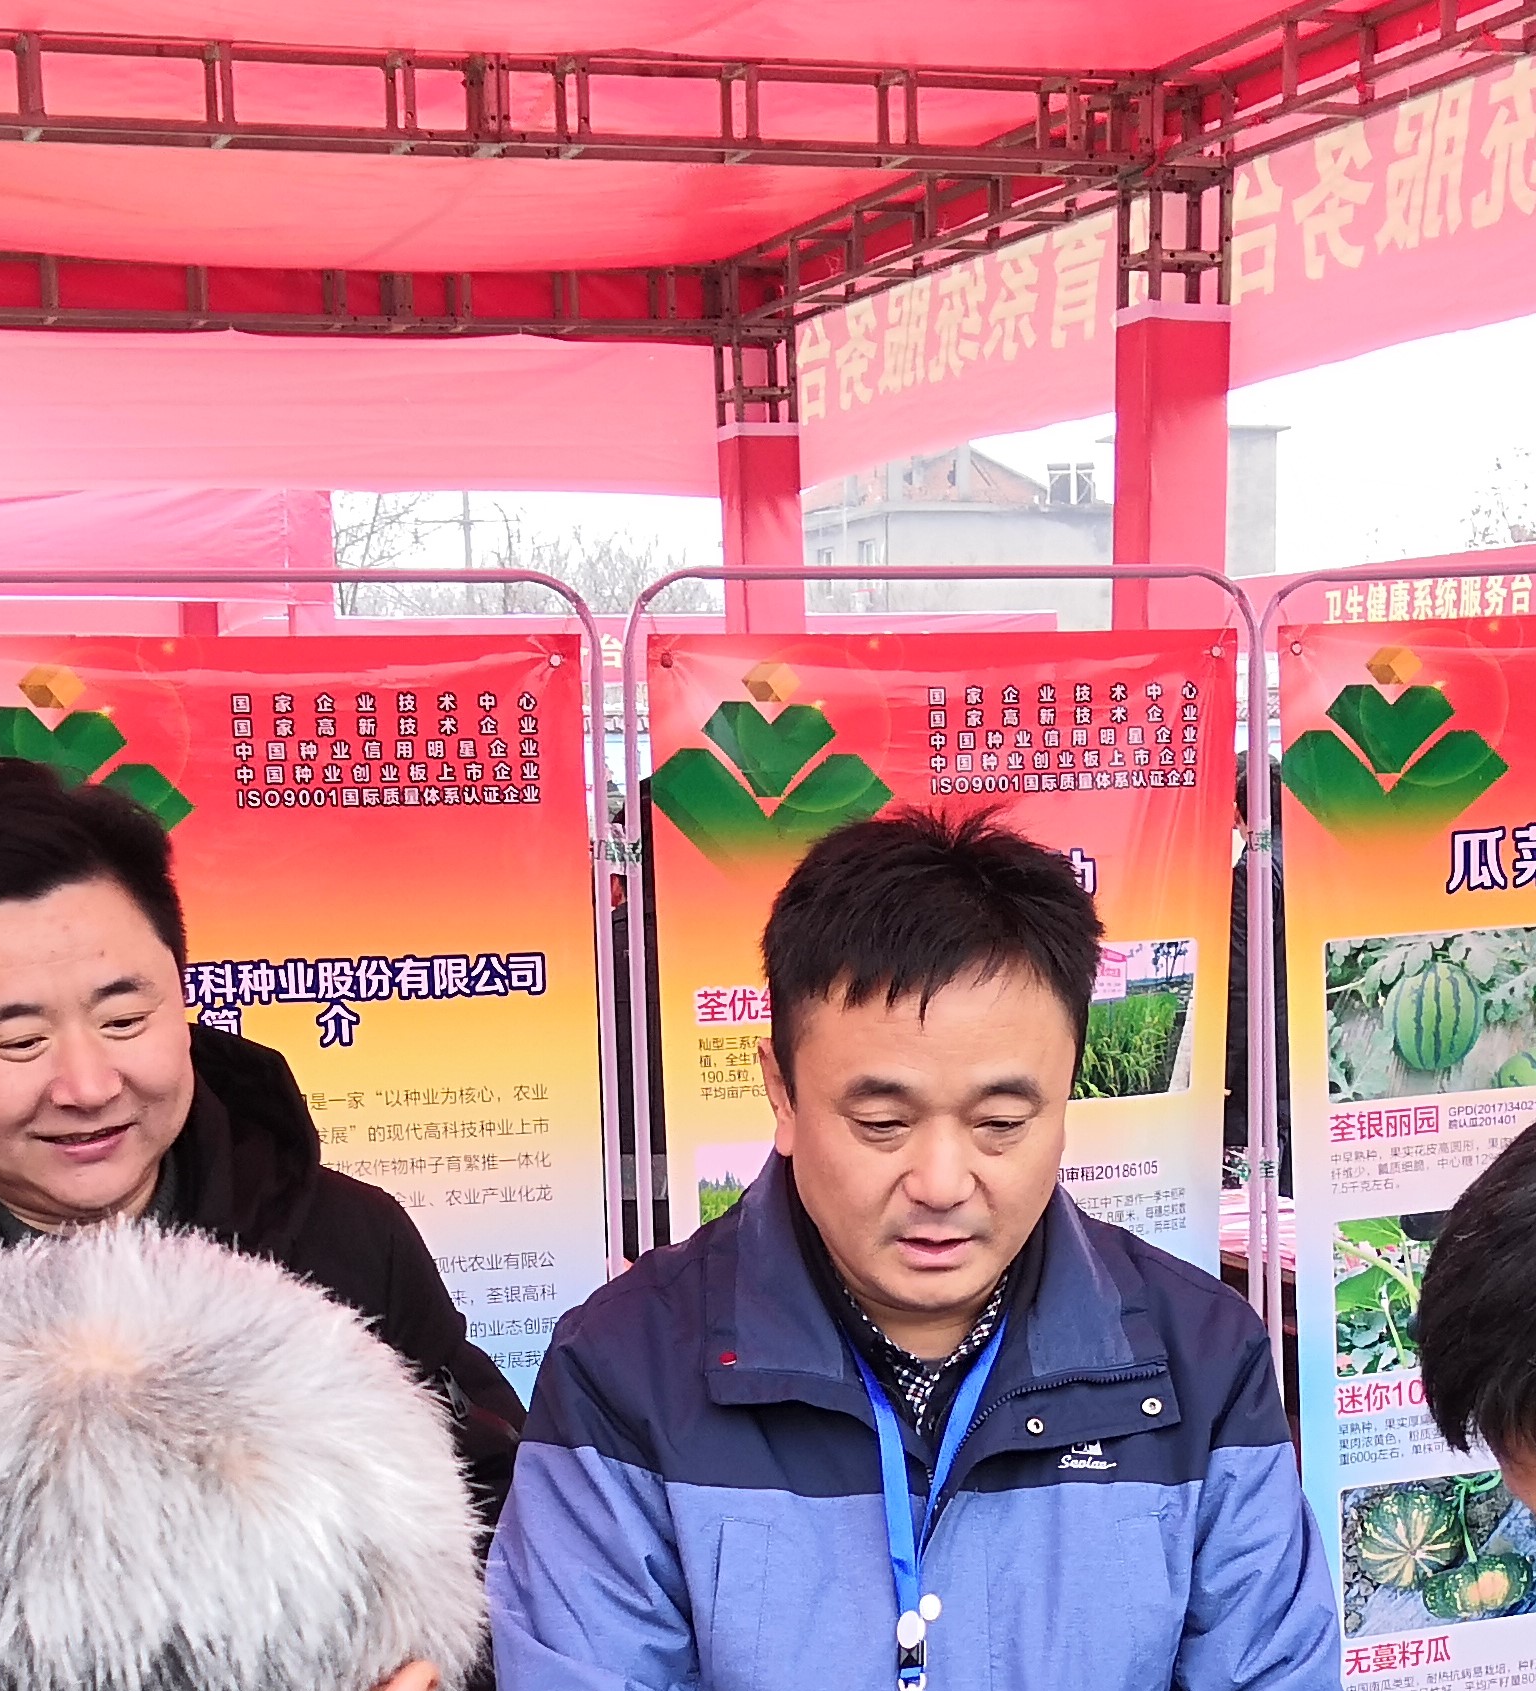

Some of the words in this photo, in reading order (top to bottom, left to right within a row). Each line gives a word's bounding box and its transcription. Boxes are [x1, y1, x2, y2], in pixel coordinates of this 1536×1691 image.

[1324, 576, 1533, 624] 卫生健康系统服务台
[231, 692, 537, 715] 国家企业技术中心
[928, 682, 1198, 707] 国家企业技术中心
[232, 716, 537, 739] 国家高新技术企业
[929, 704, 1198, 729] 国家高新技术企业
[234, 739, 538, 761] 中国种业信用明星企业
[930, 727, 1197, 751] 中国种业信用明星企业
[930, 748, 1197, 774] 中国种业创业板上市企业
[235, 763, 539, 786] 中国种业创业板上市企业
[931, 769, 1196, 795] ISO9001国际质量体系认证企业
[236, 786, 540, 809] ISO9001国际质量体系认证企业
[1330, 1105, 1439, 1143] 荃银丽园
[465, 1316, 558, 1340] 的业态创新
[490, 1351, 548, 1370] 发展我
[1345, 1636, 1451, 1676] 无蔓籽瓜
